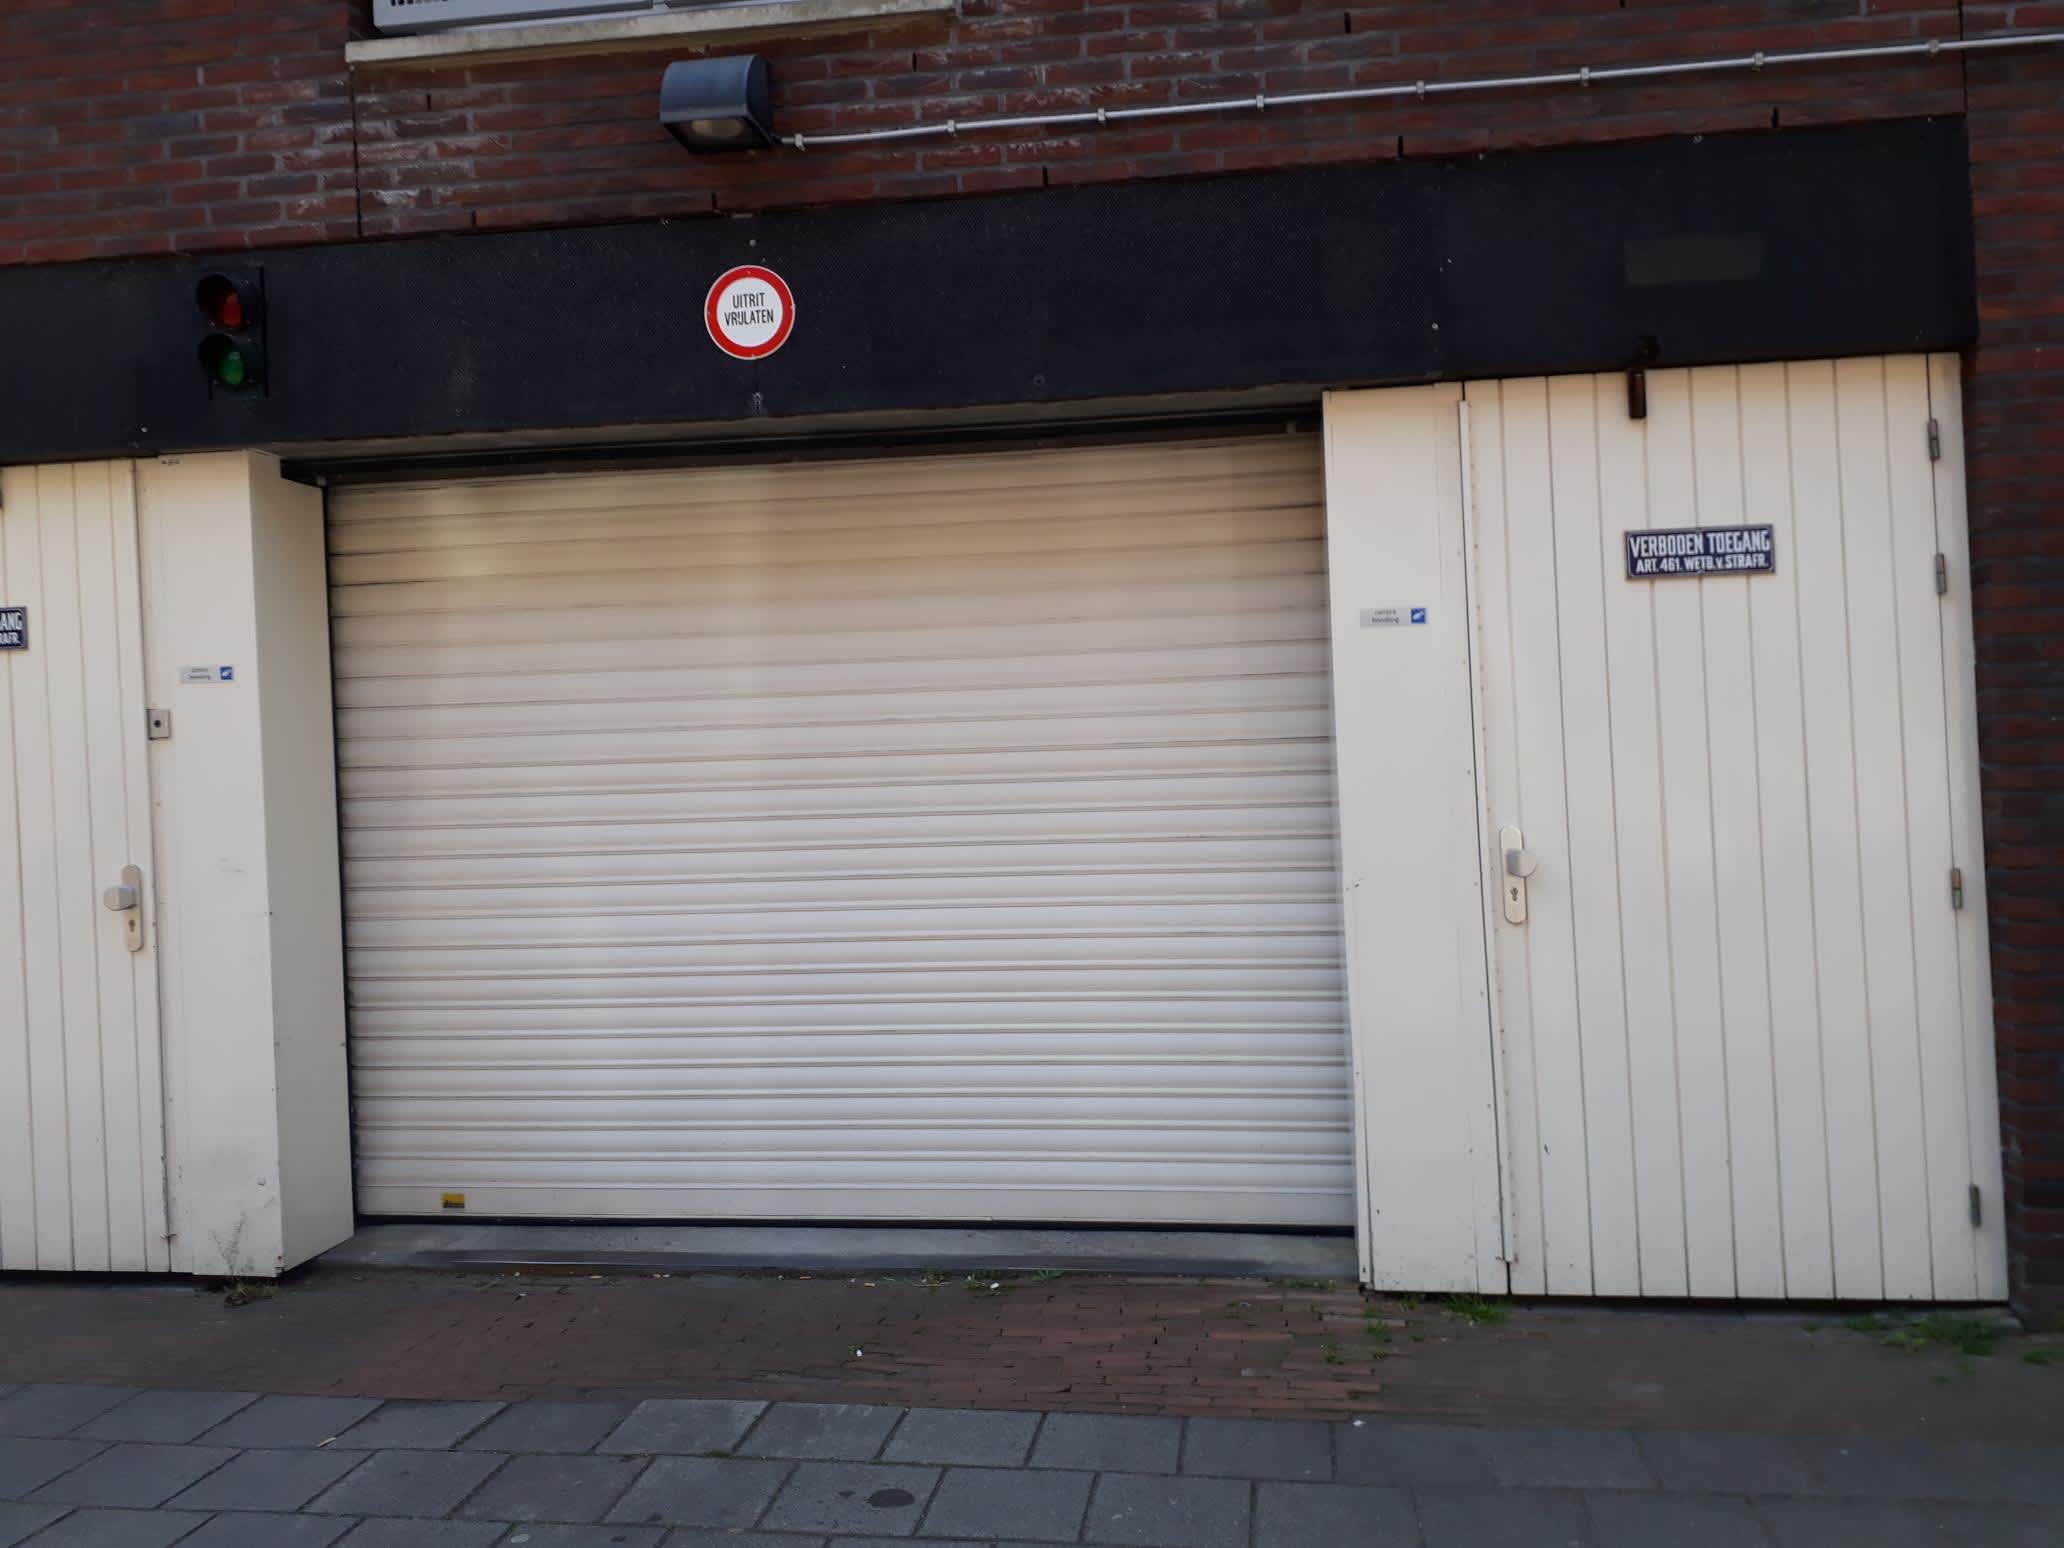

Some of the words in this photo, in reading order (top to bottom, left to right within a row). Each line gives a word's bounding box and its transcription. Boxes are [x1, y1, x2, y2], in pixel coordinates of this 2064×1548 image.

[732, 292, 766, 309] UITRIT
[1630, 533, 1704, 558] VERBODEN
[1706, 530, 1770, 554] TOEGANG
